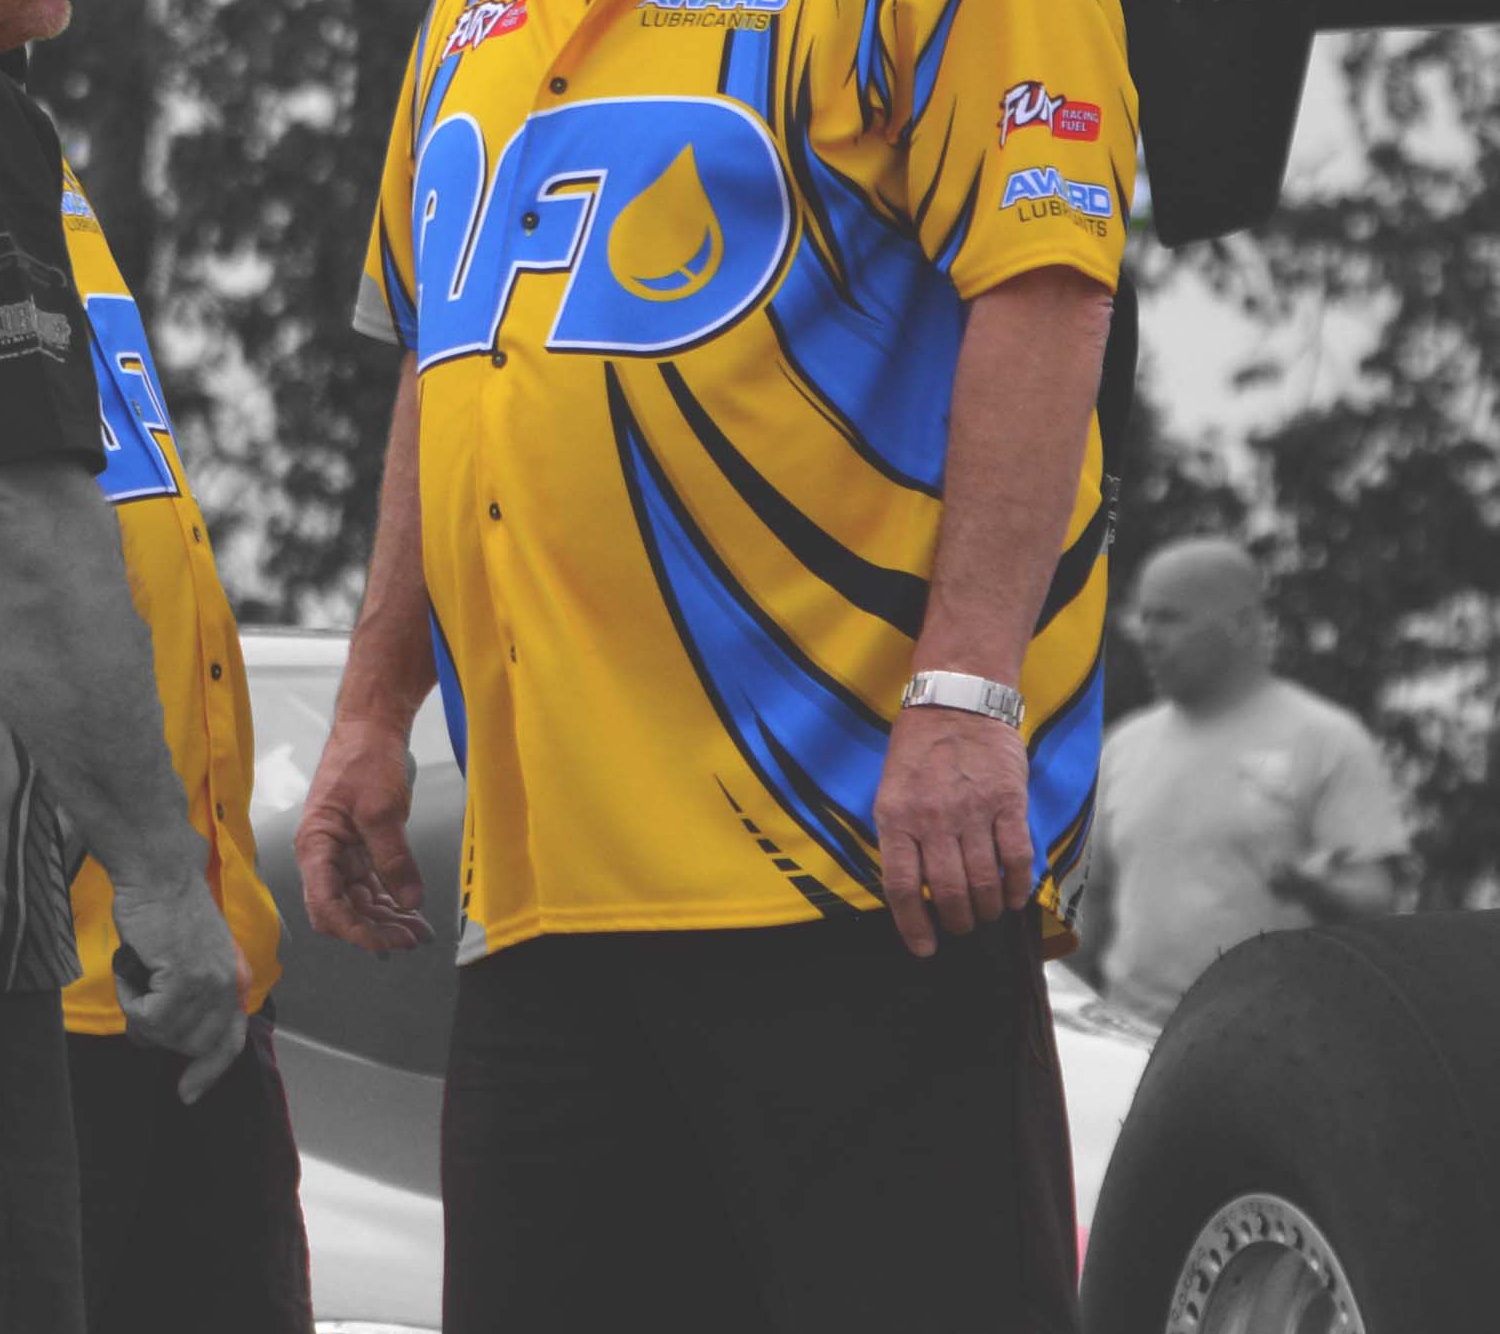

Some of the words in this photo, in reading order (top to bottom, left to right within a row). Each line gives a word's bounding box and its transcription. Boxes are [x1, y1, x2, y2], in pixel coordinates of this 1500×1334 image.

[640, 11, 769, 30] LUBRICANTS
[1060, 121, 1088, 132] FUEL
[1001, 167, 1113, 218] AWRD
